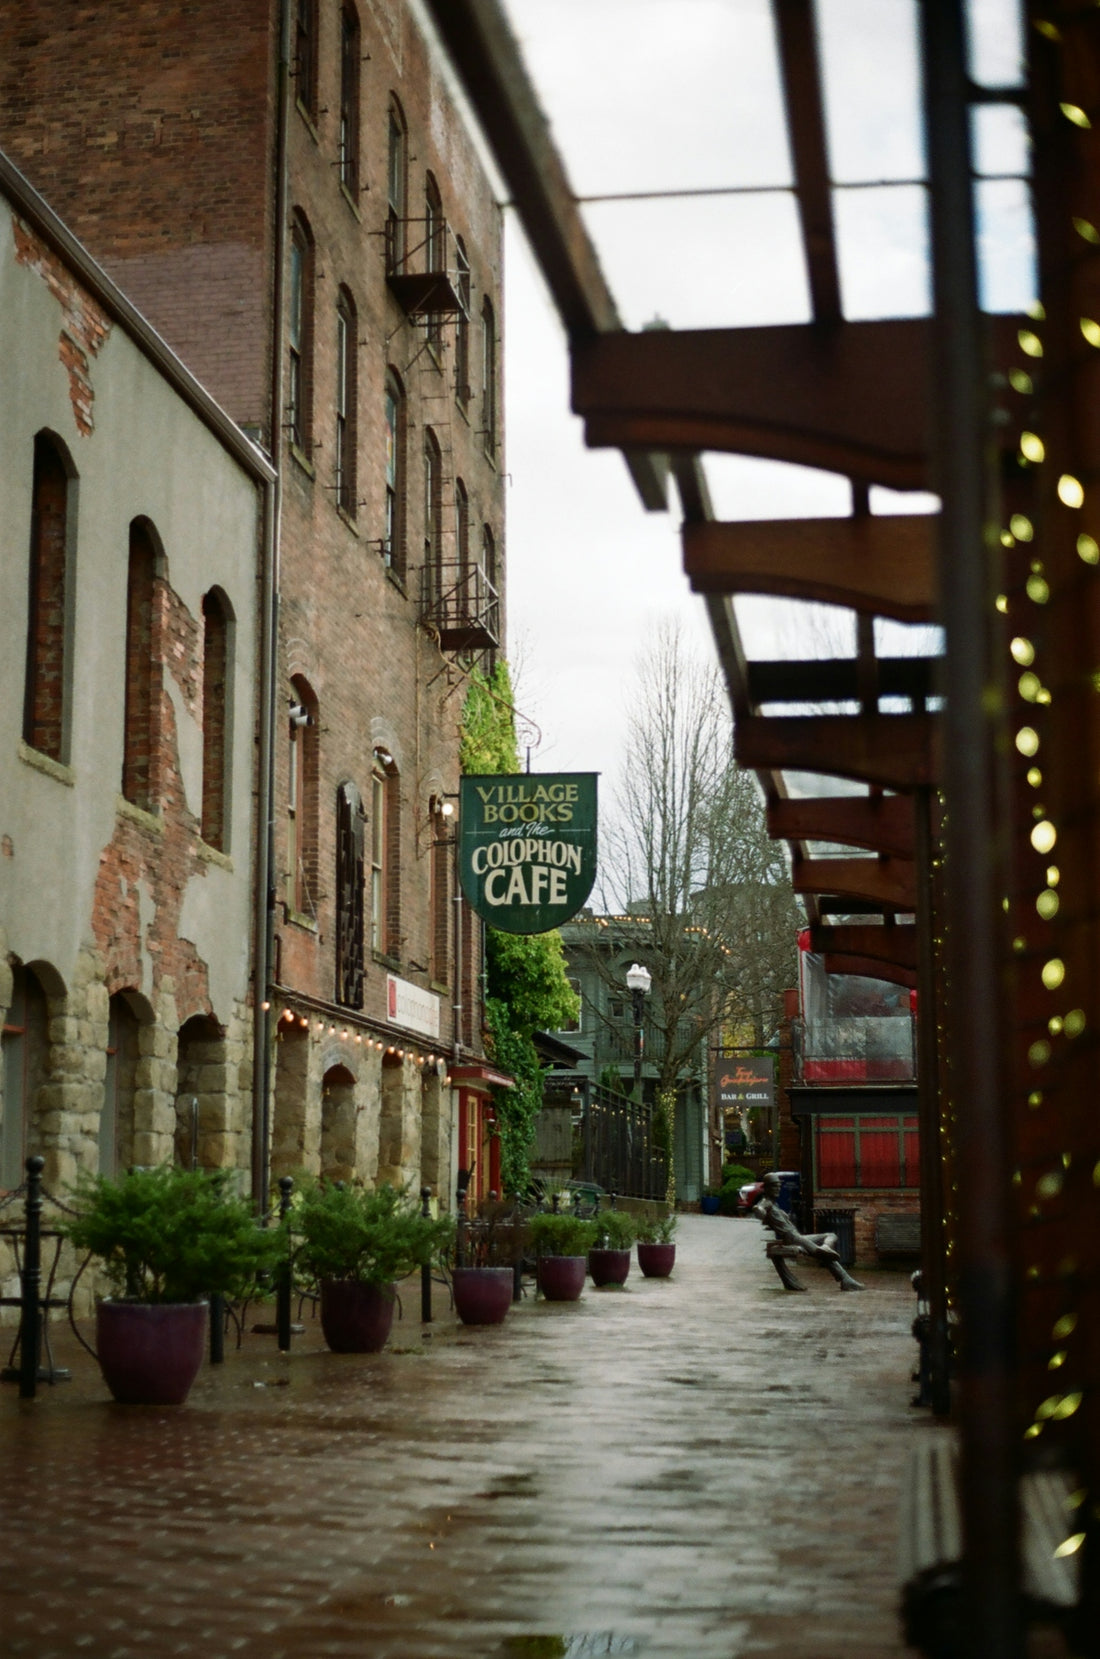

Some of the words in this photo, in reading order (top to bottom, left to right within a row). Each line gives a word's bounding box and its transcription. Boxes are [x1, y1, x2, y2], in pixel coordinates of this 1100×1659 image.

[475, 784, 579, 803] VILLAGE
[483, 803, 573, 823] BOOKS
[499, 823, 526, 838] and
[472, 838, 582, 876] COLOPHON
[485, 865, 568, 906] CAFE
[746, 1092, 769, 1100] GRILL
